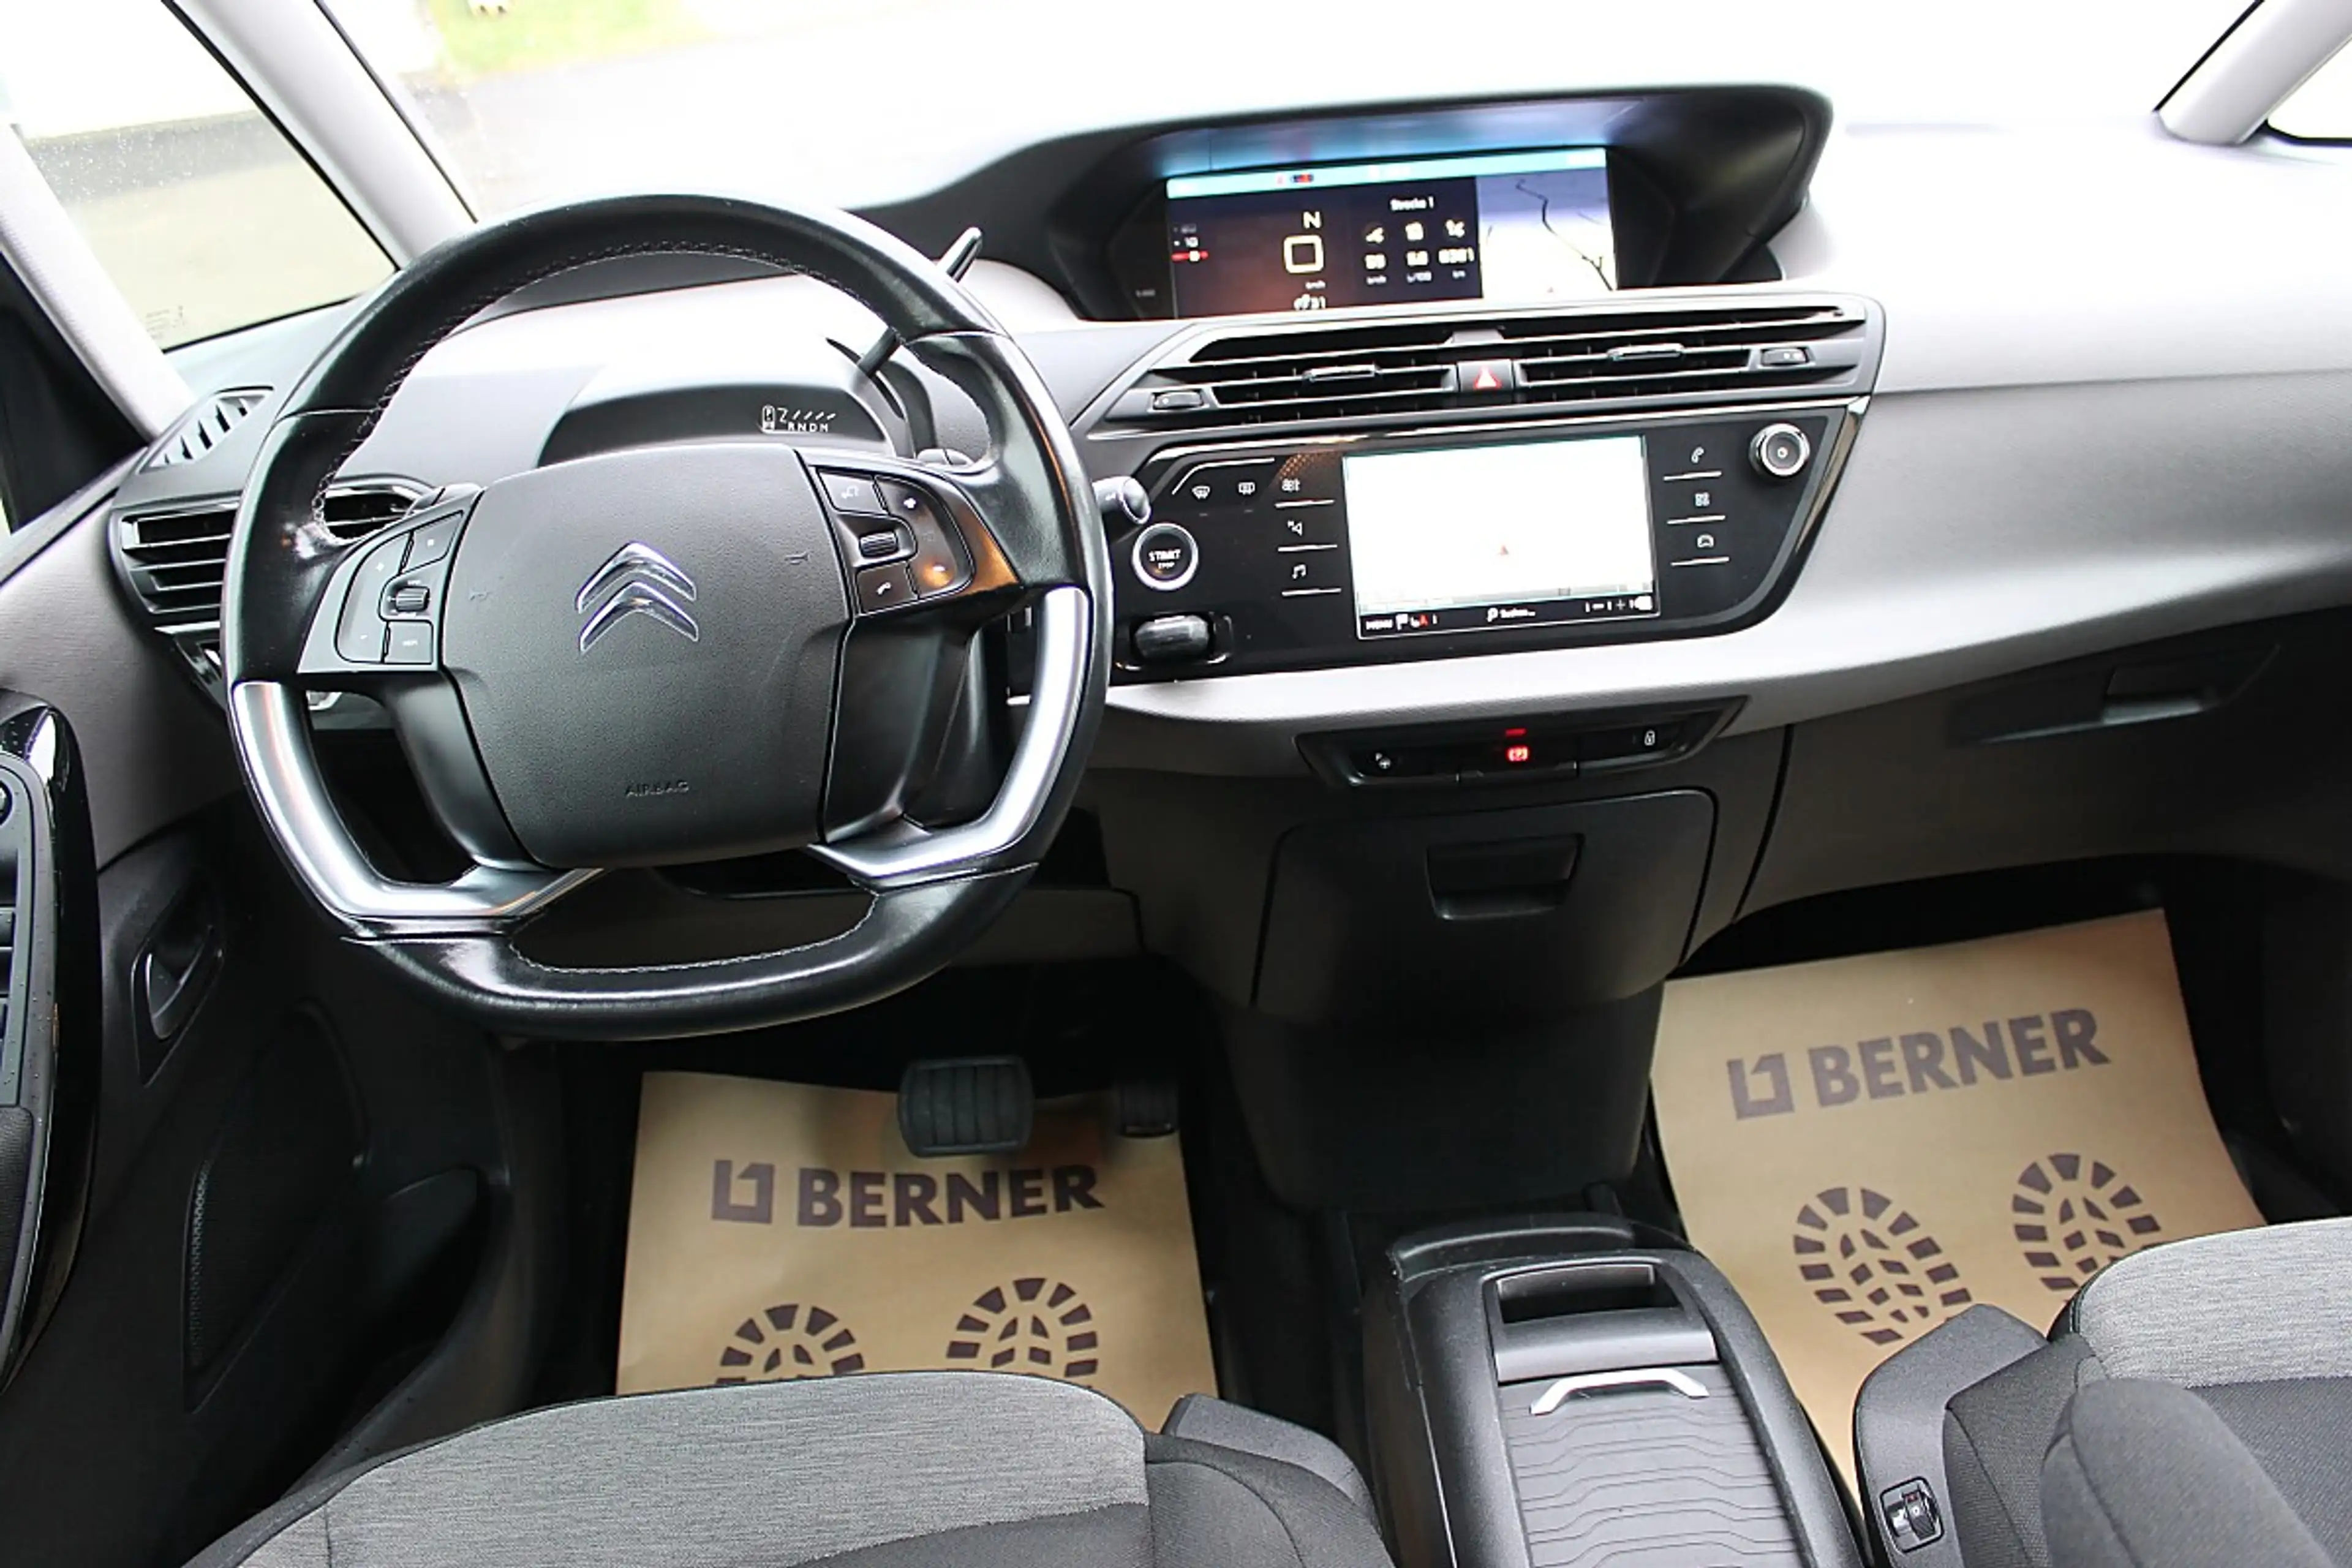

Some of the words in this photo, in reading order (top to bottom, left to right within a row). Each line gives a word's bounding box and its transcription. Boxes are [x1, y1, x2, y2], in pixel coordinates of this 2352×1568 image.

[1303, 211, 1322, 229] N
[625, 779, 689, 798] AIRBAG
[1808, 1008, 2112, 1107] BERNER
[797, 1166, 1105, 1227] BERNER
